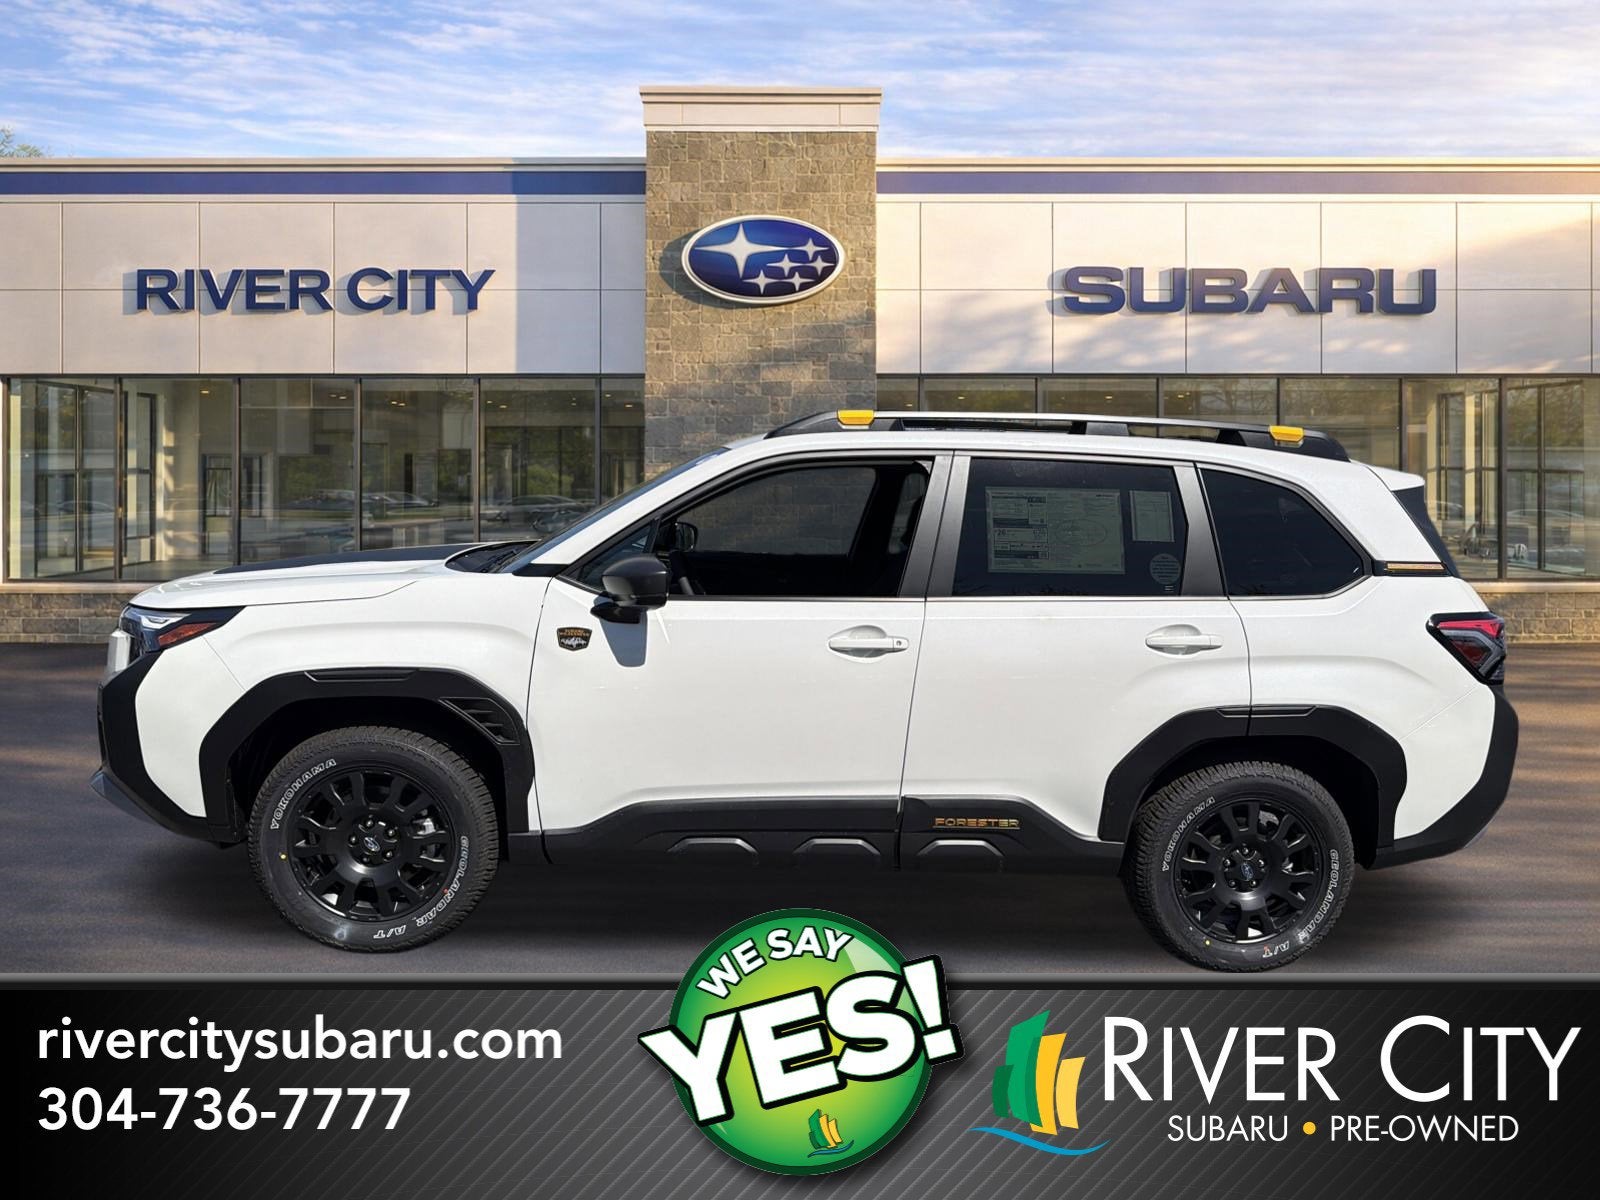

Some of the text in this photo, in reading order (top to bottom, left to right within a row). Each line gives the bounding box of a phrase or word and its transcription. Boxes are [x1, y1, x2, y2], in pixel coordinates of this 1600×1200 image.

[137, 267, 496, 311] RIVER CITY
[1063, 266, 1437, 315] SUBARU
[271, 758, 337, 830] YOKOHAMA
[935, 817, 1019, 828] FORESTER
[1162, 796, 1216, 872] YOKOHAMA
[373, 834, 470, 940] GEOLANDAR A/T
[1297, 848, 1340, 944] GEOLANDAR
